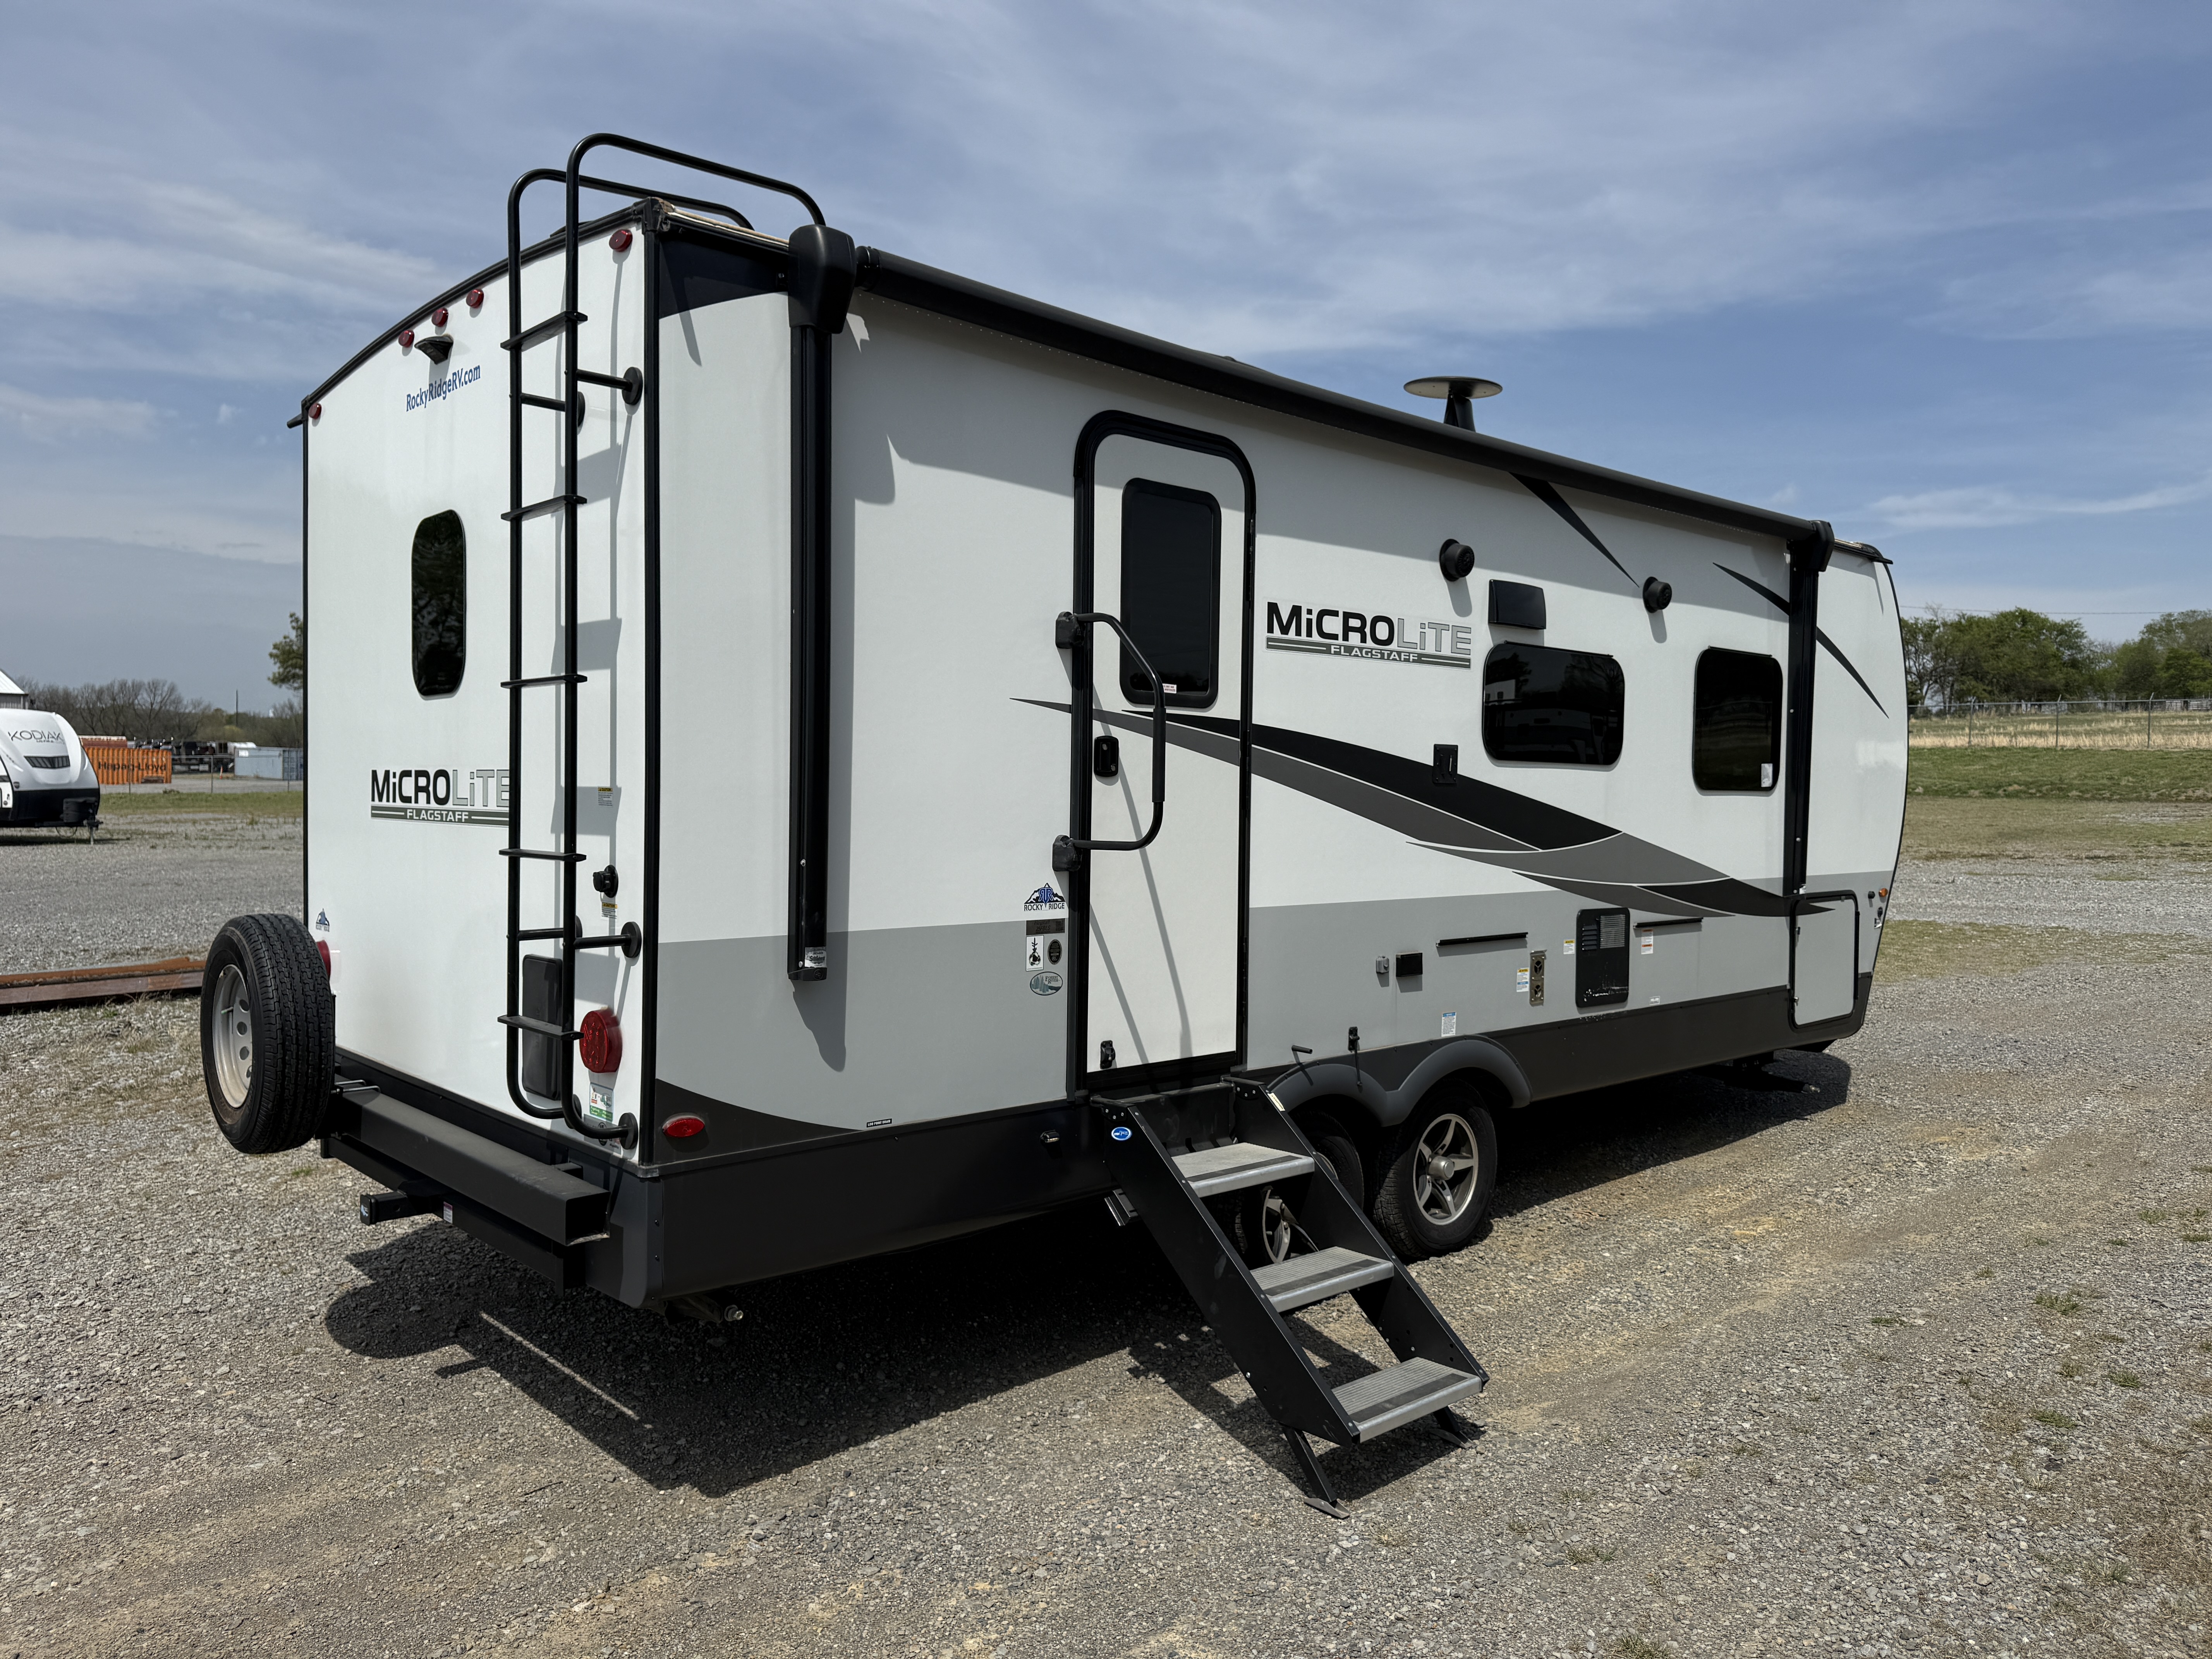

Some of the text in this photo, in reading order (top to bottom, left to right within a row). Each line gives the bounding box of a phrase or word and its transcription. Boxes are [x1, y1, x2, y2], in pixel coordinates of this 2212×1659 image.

[406, 365, 480, 412] RockyRidgeRV.com
[1331, 645, 1418, 662] FLAGSTAFF
[8, 730, 65, 741] KODIAK
[407, 809, 469, 823] FLAGSTAFF
